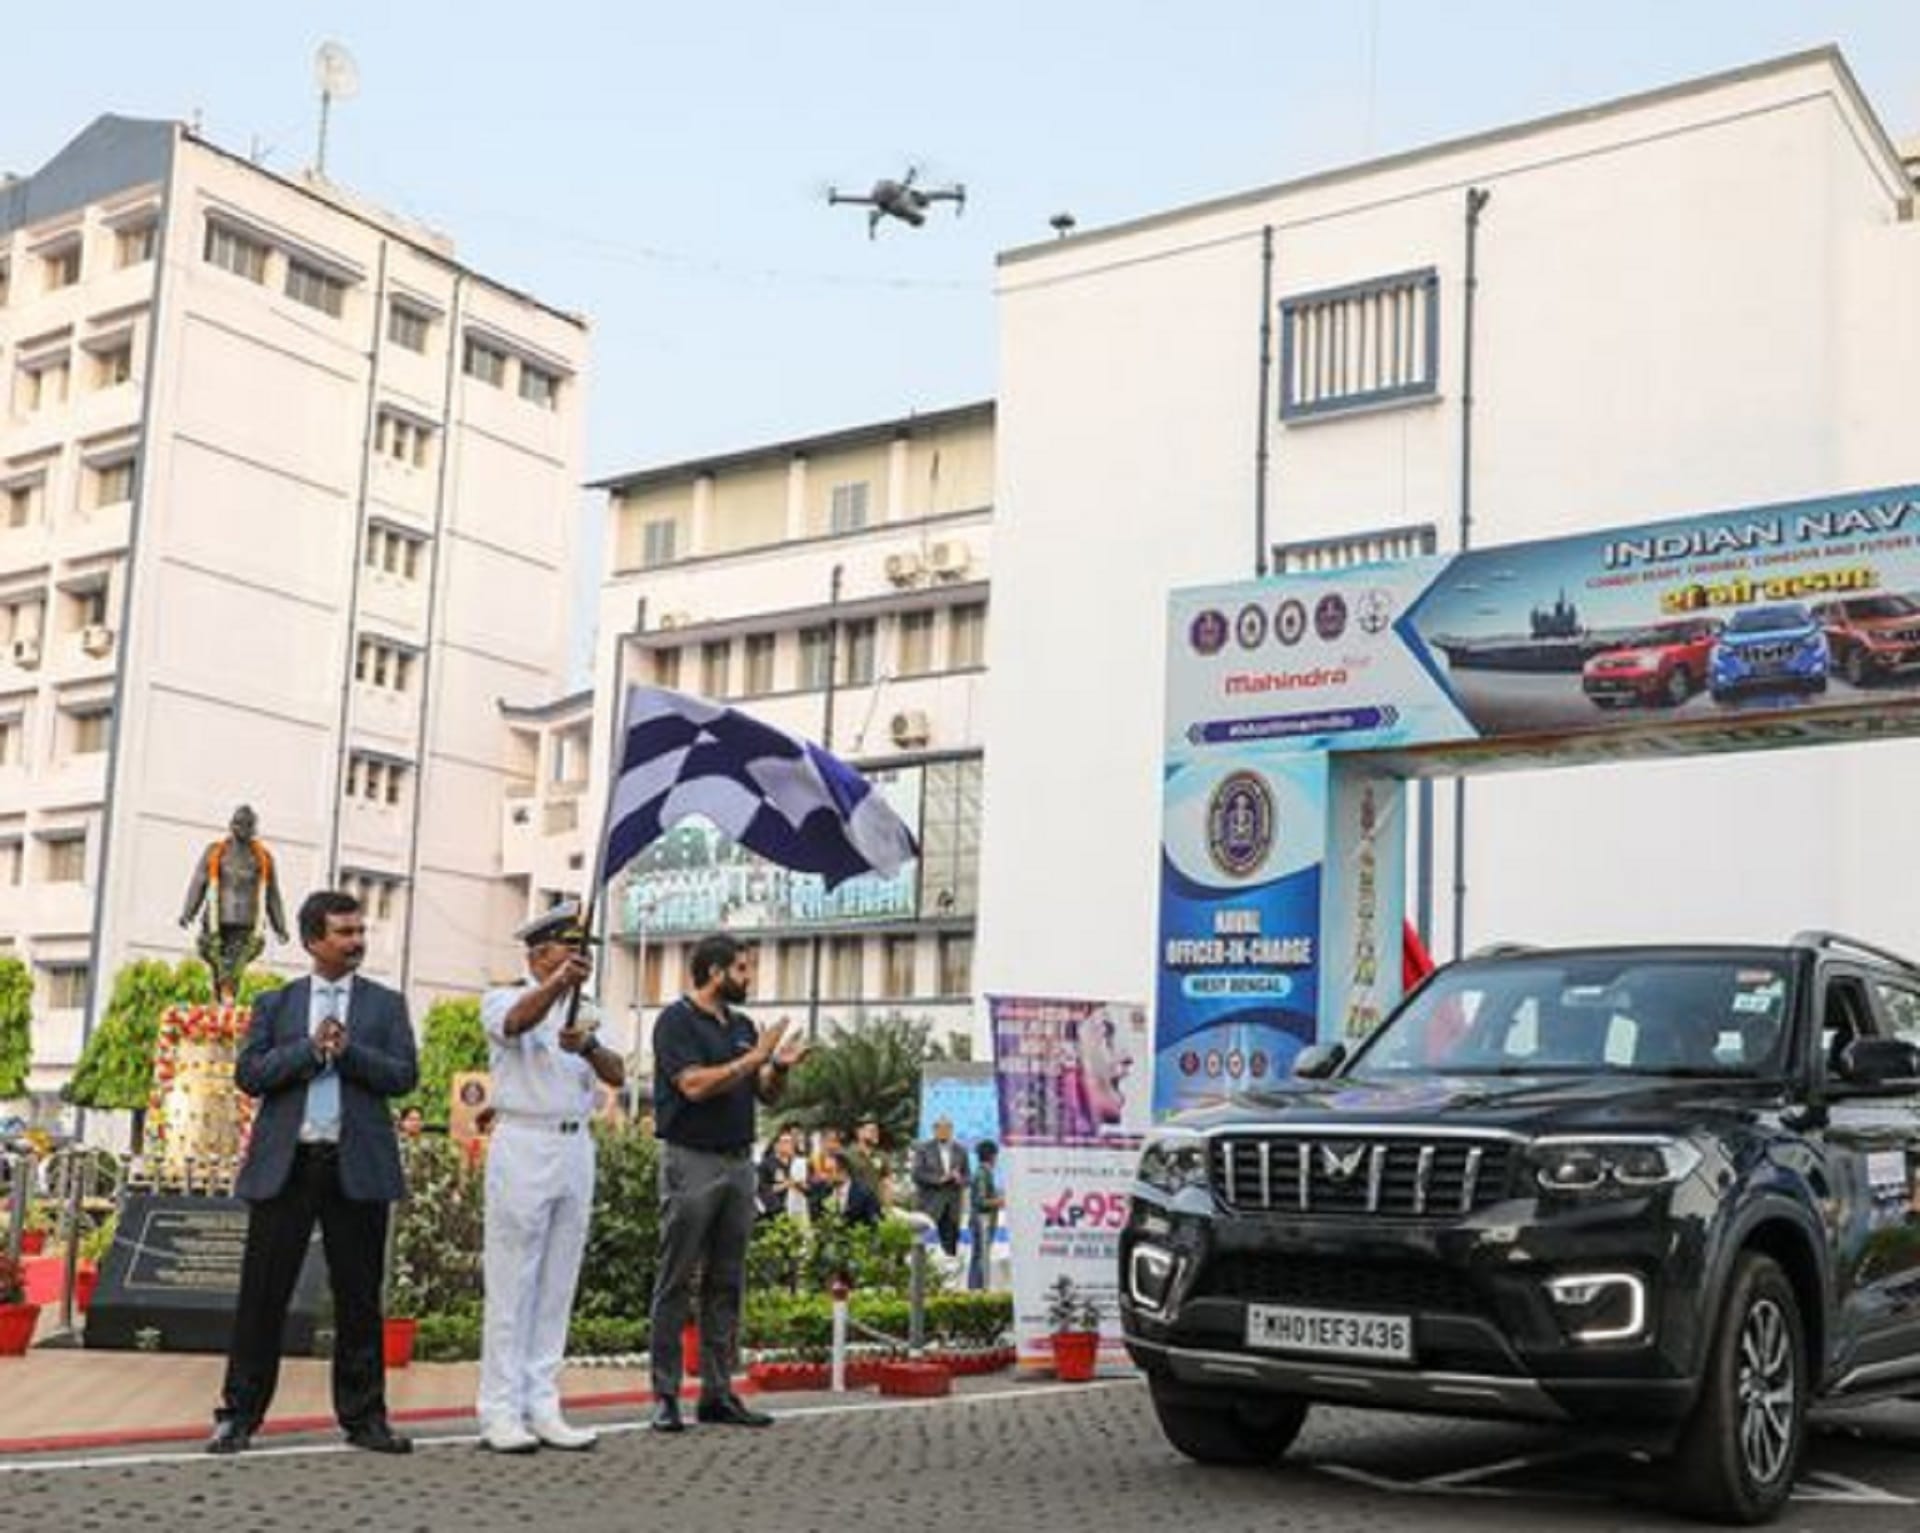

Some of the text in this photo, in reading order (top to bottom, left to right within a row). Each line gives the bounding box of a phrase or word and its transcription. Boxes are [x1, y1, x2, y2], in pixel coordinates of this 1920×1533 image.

[1604, 519, 1782, 569] INDIAN
[1214, 909, 1263, 934] NAVAL
[1166, 937, 1313, 965] OFFICER-IN-CHARGE
[1191, 976, 1283, 993] WEST BENGAL
[1264, 1314, 1405, 1350] MH01EF3436
